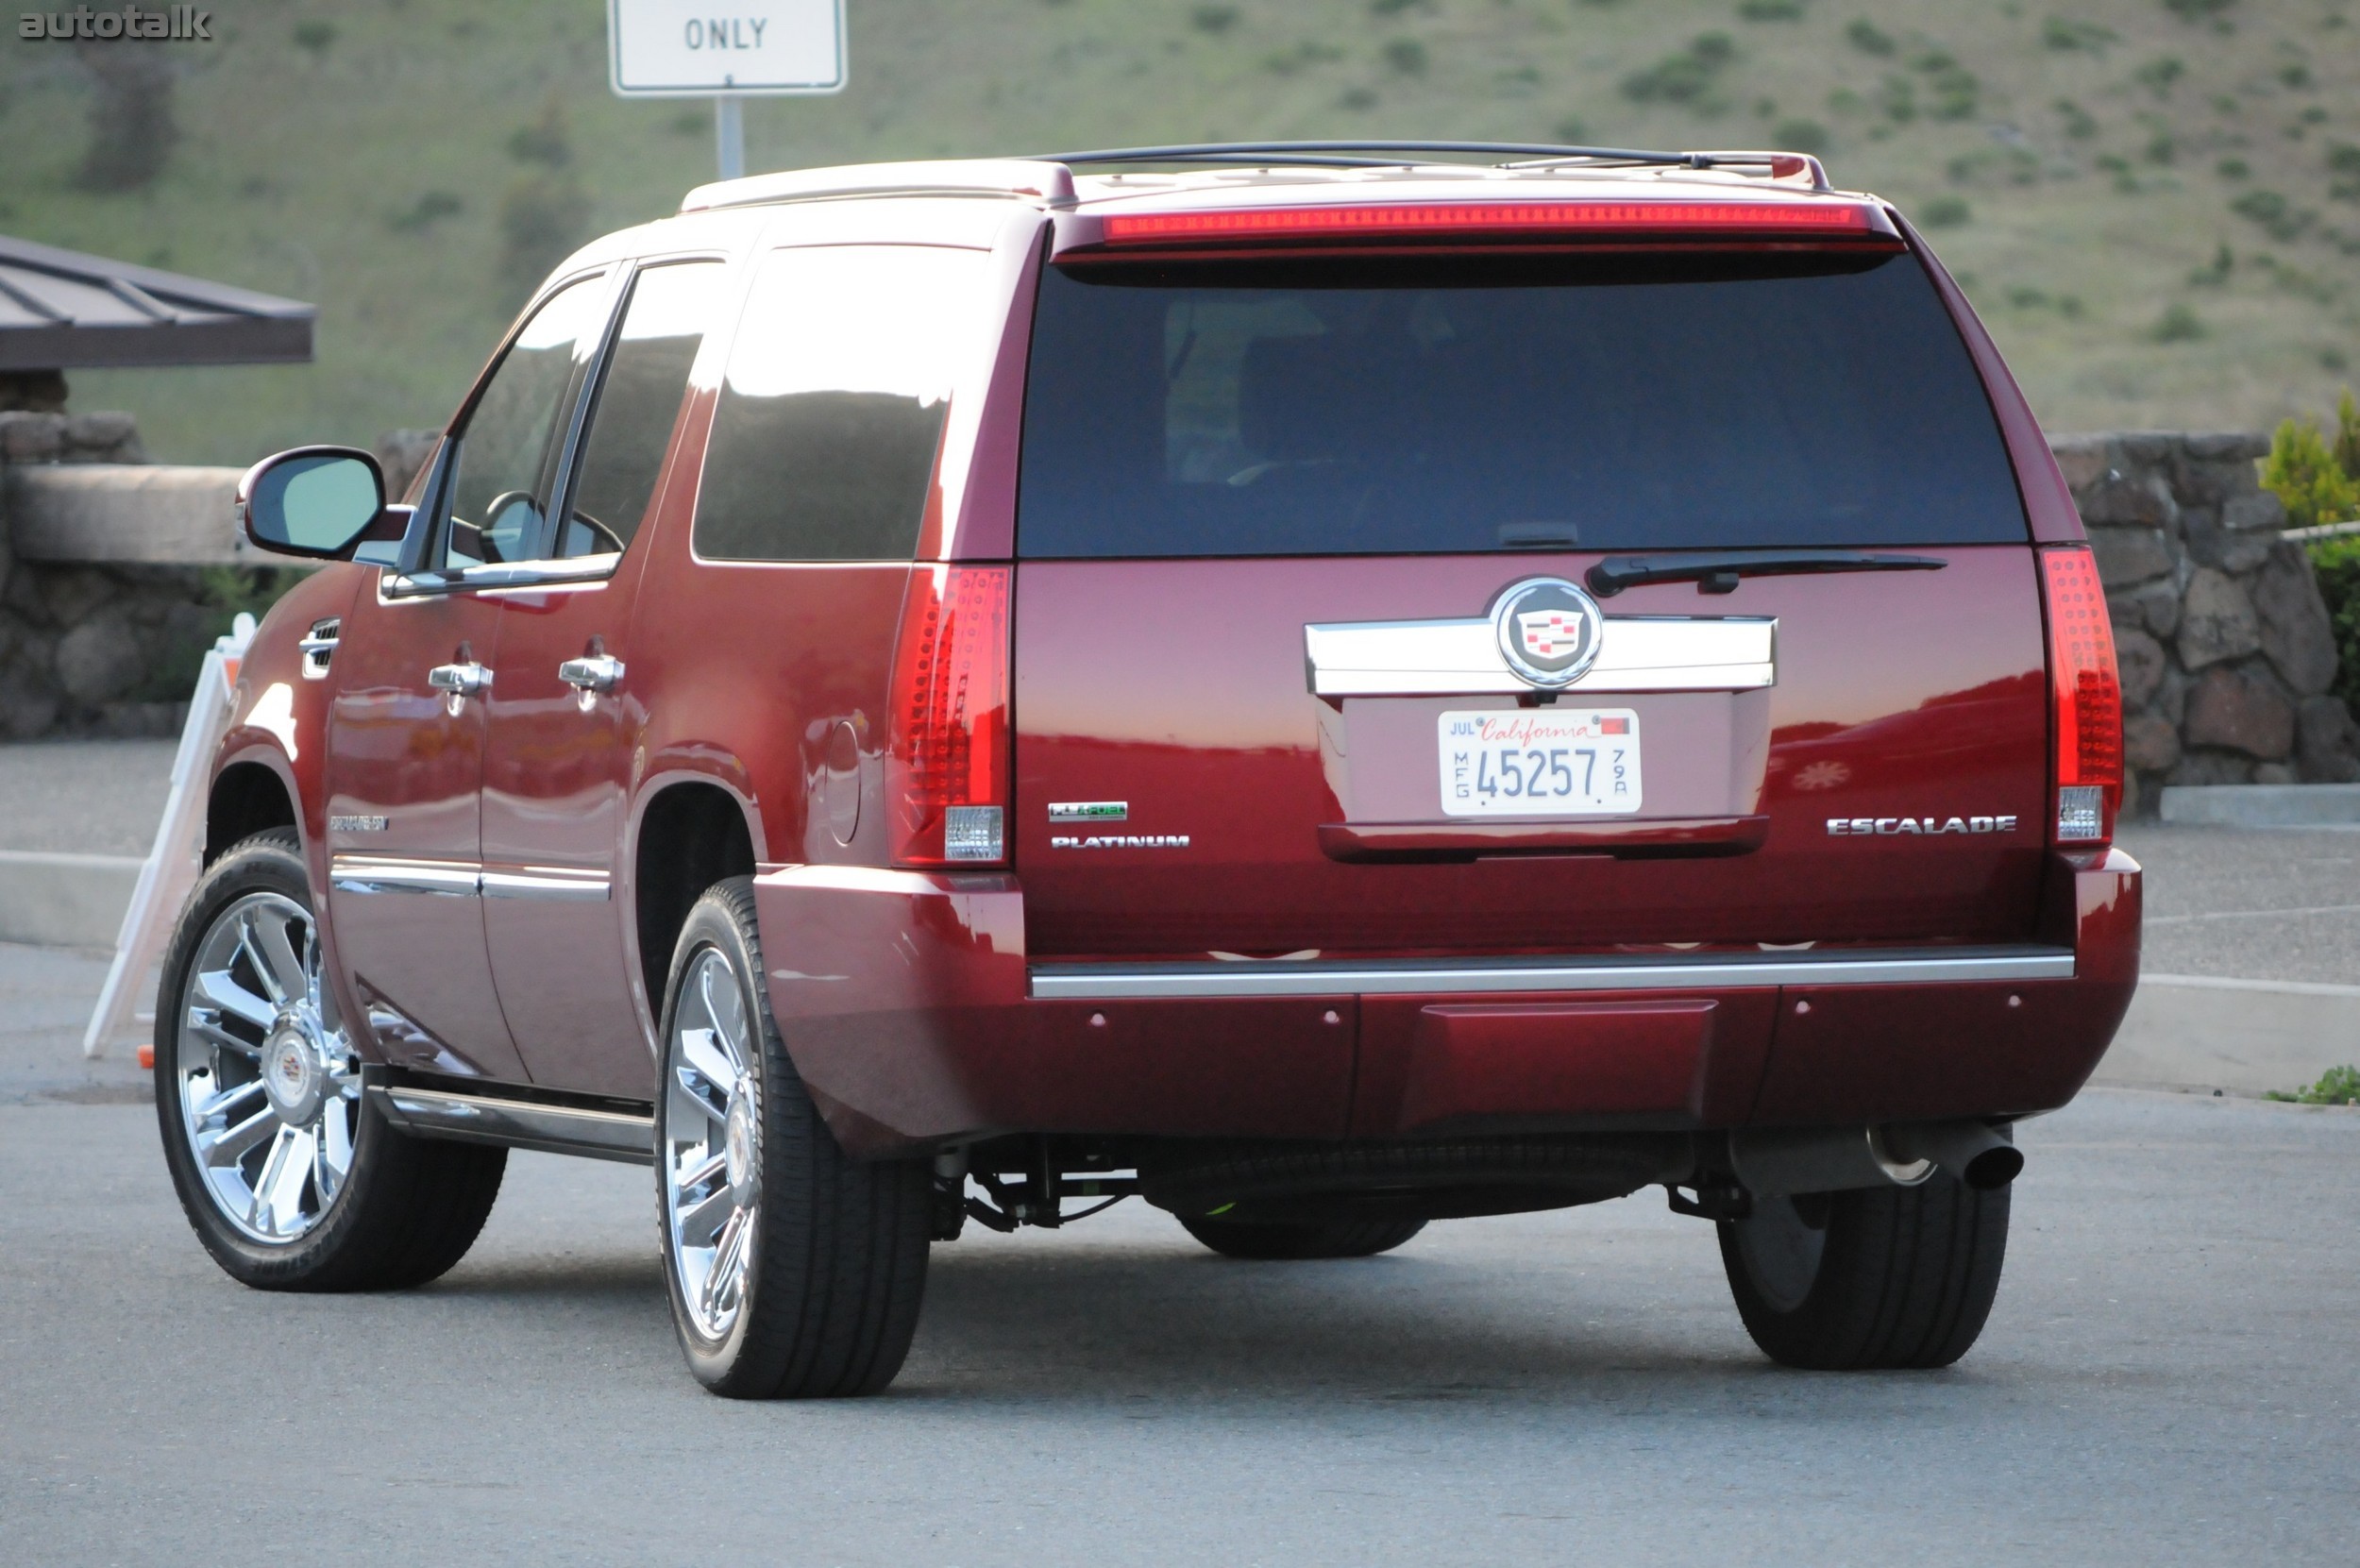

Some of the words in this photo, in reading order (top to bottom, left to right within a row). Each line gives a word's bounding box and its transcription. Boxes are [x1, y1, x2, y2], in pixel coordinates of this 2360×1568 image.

[684, 18, 767, 50] ONLY
[1450, 721, 1475, 736] JUL
[1480, 717, 1602, 748] California
[1476, 749, 1596, 798] 45257
[1827, 816, 2017, 835] ESCALADE
[1051, 835, 1190, 849] PLATINUM
